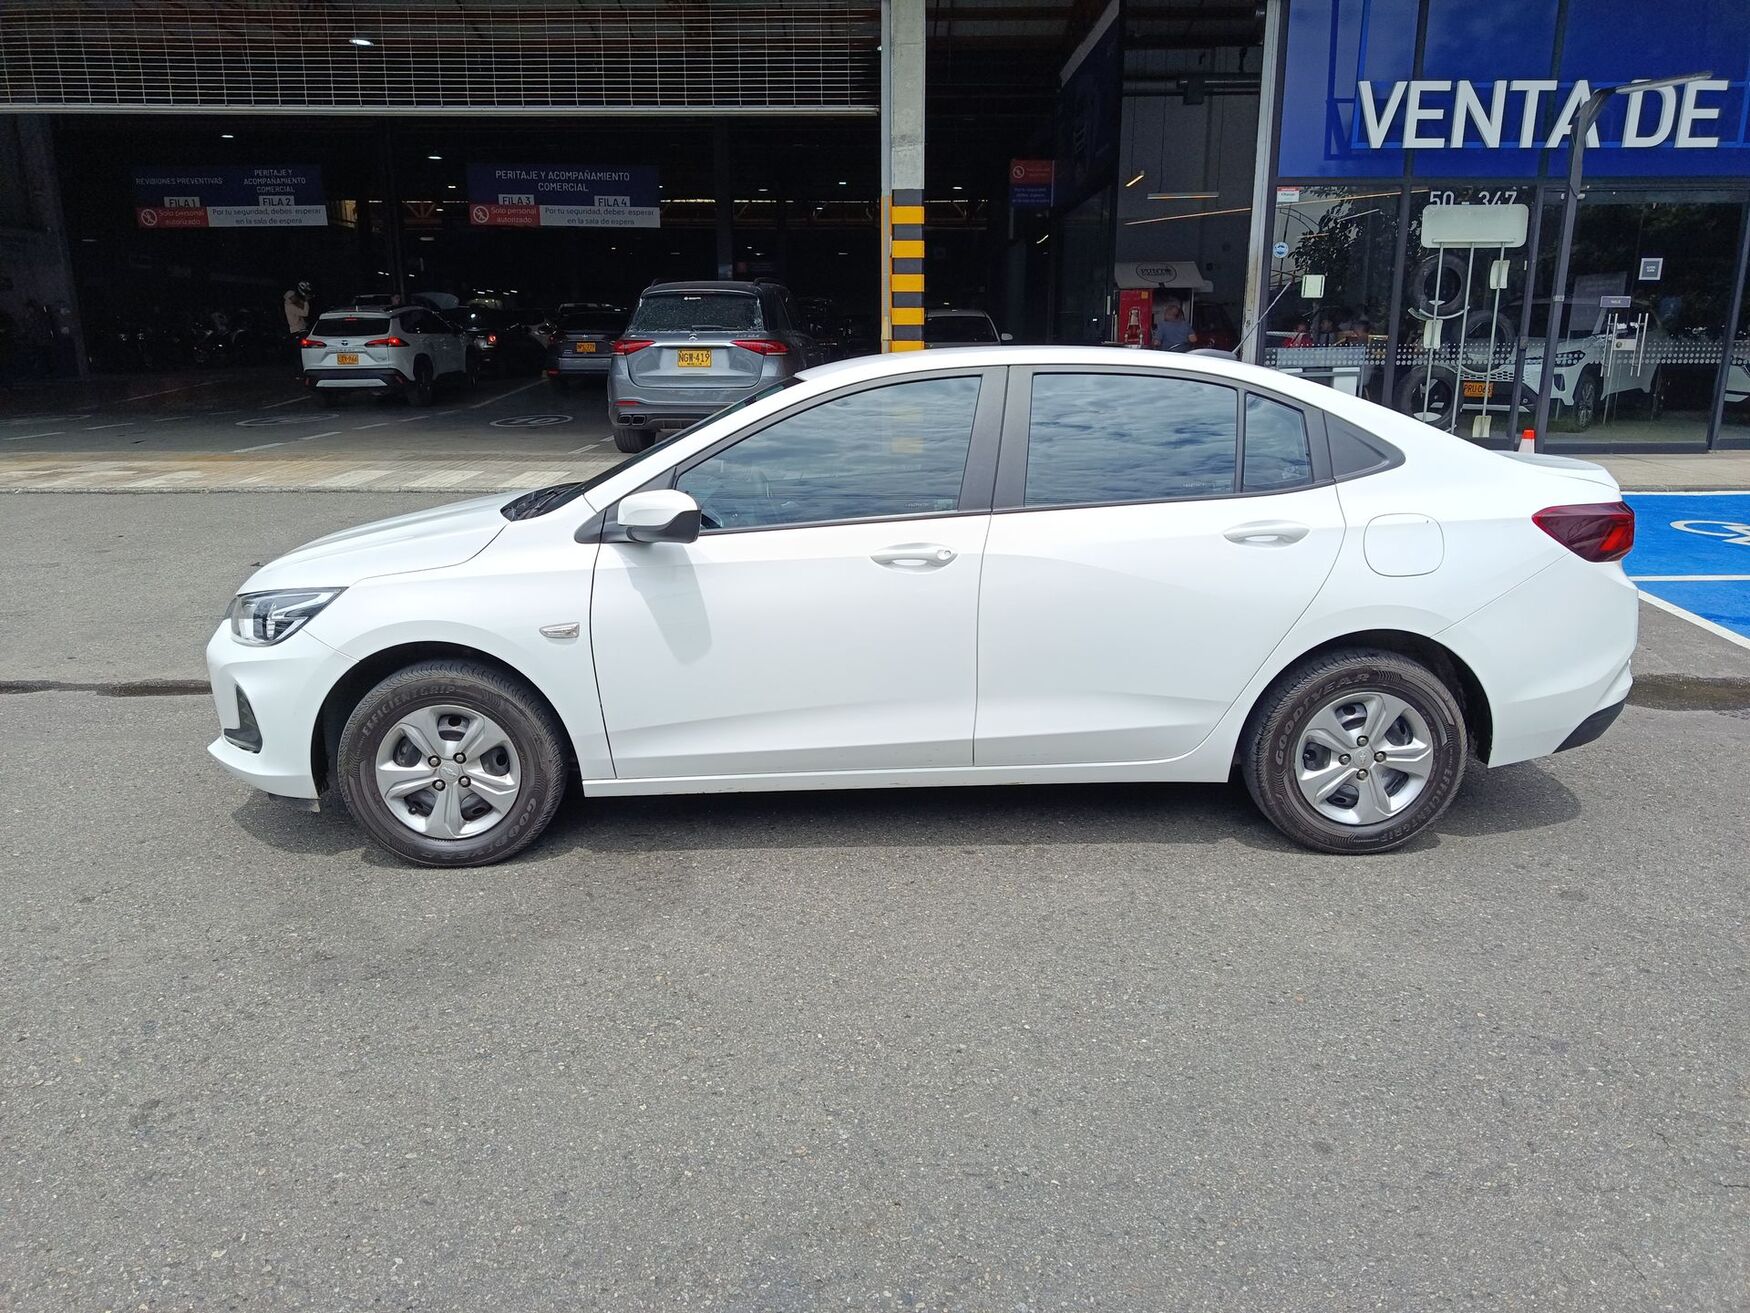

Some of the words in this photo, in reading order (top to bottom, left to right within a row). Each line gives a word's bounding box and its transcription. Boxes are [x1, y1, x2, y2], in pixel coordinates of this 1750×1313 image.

[1358, 79, 1600, 149] VENTA
[1621, 78, 1729, 149] DE
[495, 170, 538, 180] PERITAJE
[540, 171, 546, 180] Y
[548, 169, 630, 181] ACOMPAÑAMIENTO
[537, 182, 589, 192] COMERCIAL
[169, 198, 190, 207] FILA
[262, 197, 284, 206] FILA
[285, 197, 292, 206] 2
[502, 196, 523, 205] FILA
[525, 196, 531, 205] 3
[598, 197, 620, 207] FILA
[621, 197, 627, 207] 4
[1429, 190, 1455, 206] 50
[1275, 672, 1370, 766] GOODYEAR
